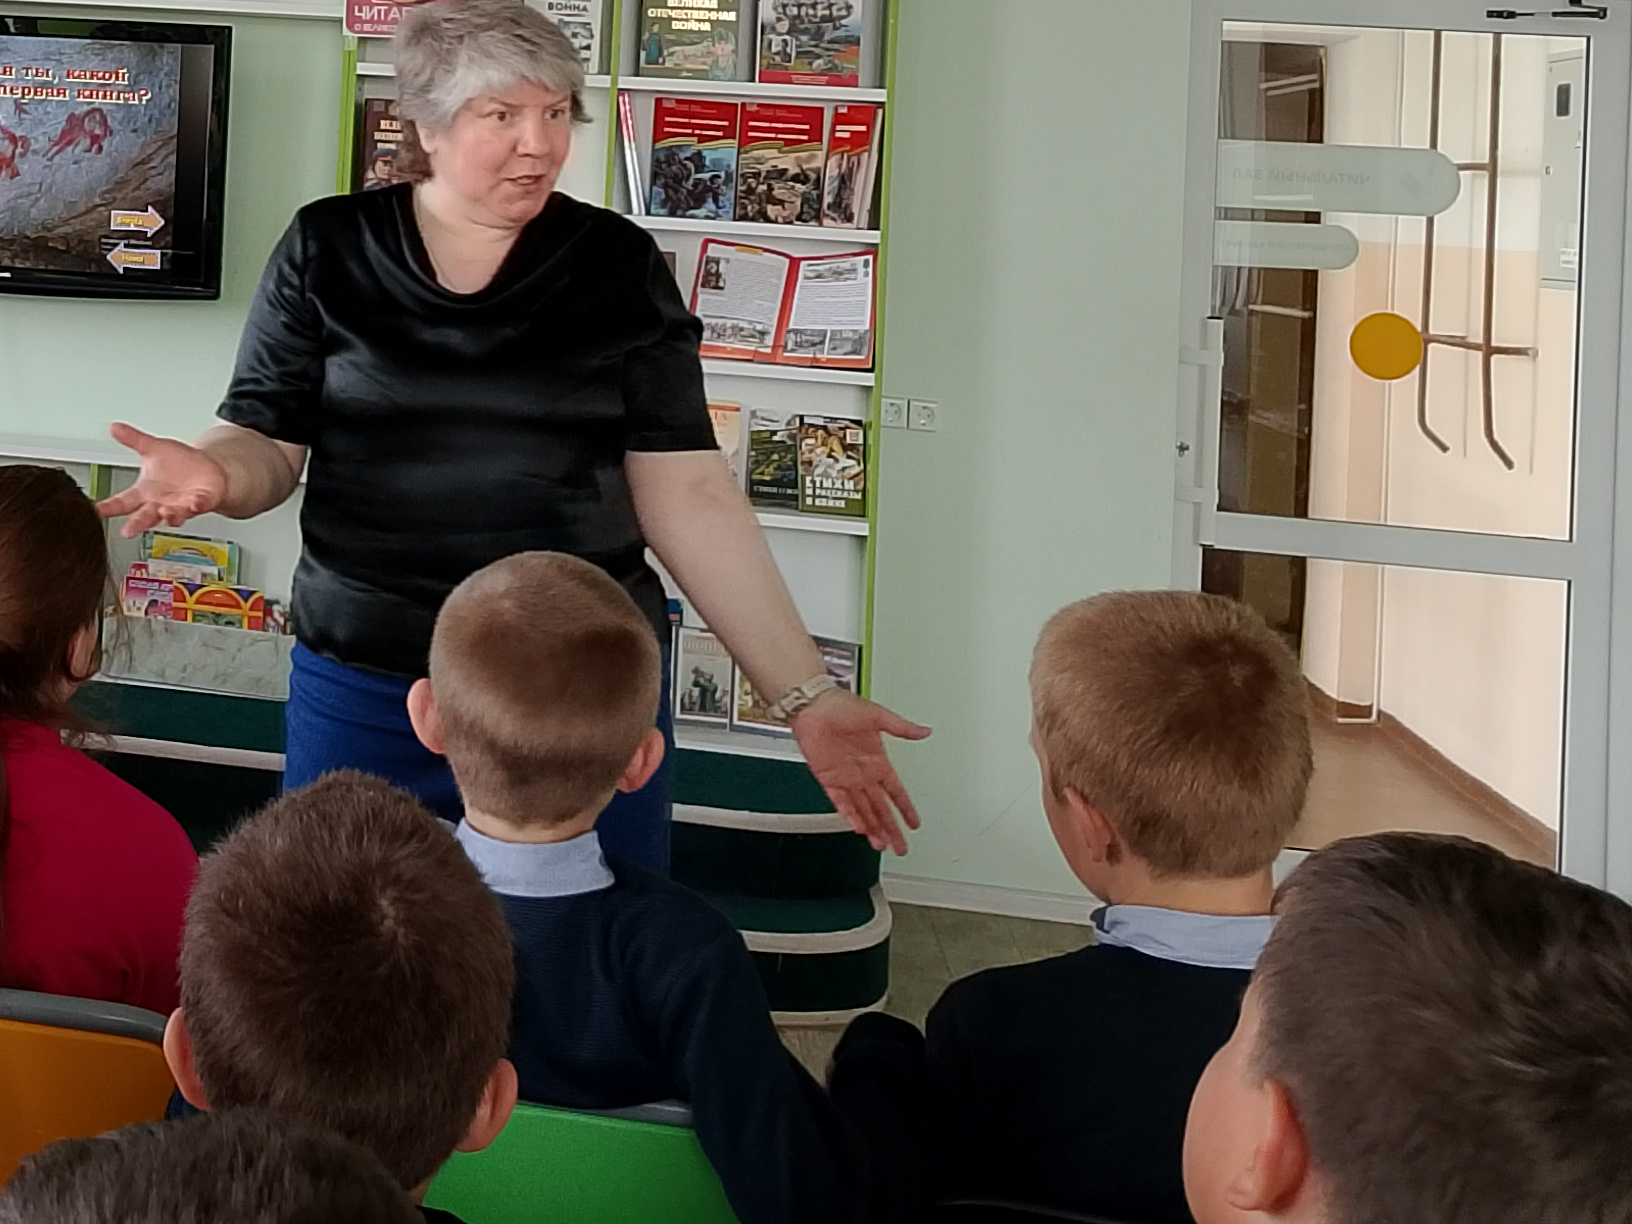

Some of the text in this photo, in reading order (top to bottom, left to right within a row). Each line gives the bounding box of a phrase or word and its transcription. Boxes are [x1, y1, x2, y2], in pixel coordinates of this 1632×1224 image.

[648, 8, 737, 21] ОТЕЧЕСТВЕННАЯ
[671, 19, 711, 31] ВОЙНА
[22, 66, 59, 84] ты,
[65, 67, 129, 84] какой
[76, 86, 151, 104] книга?
[806, 476, 855, 491] СТИХИ
